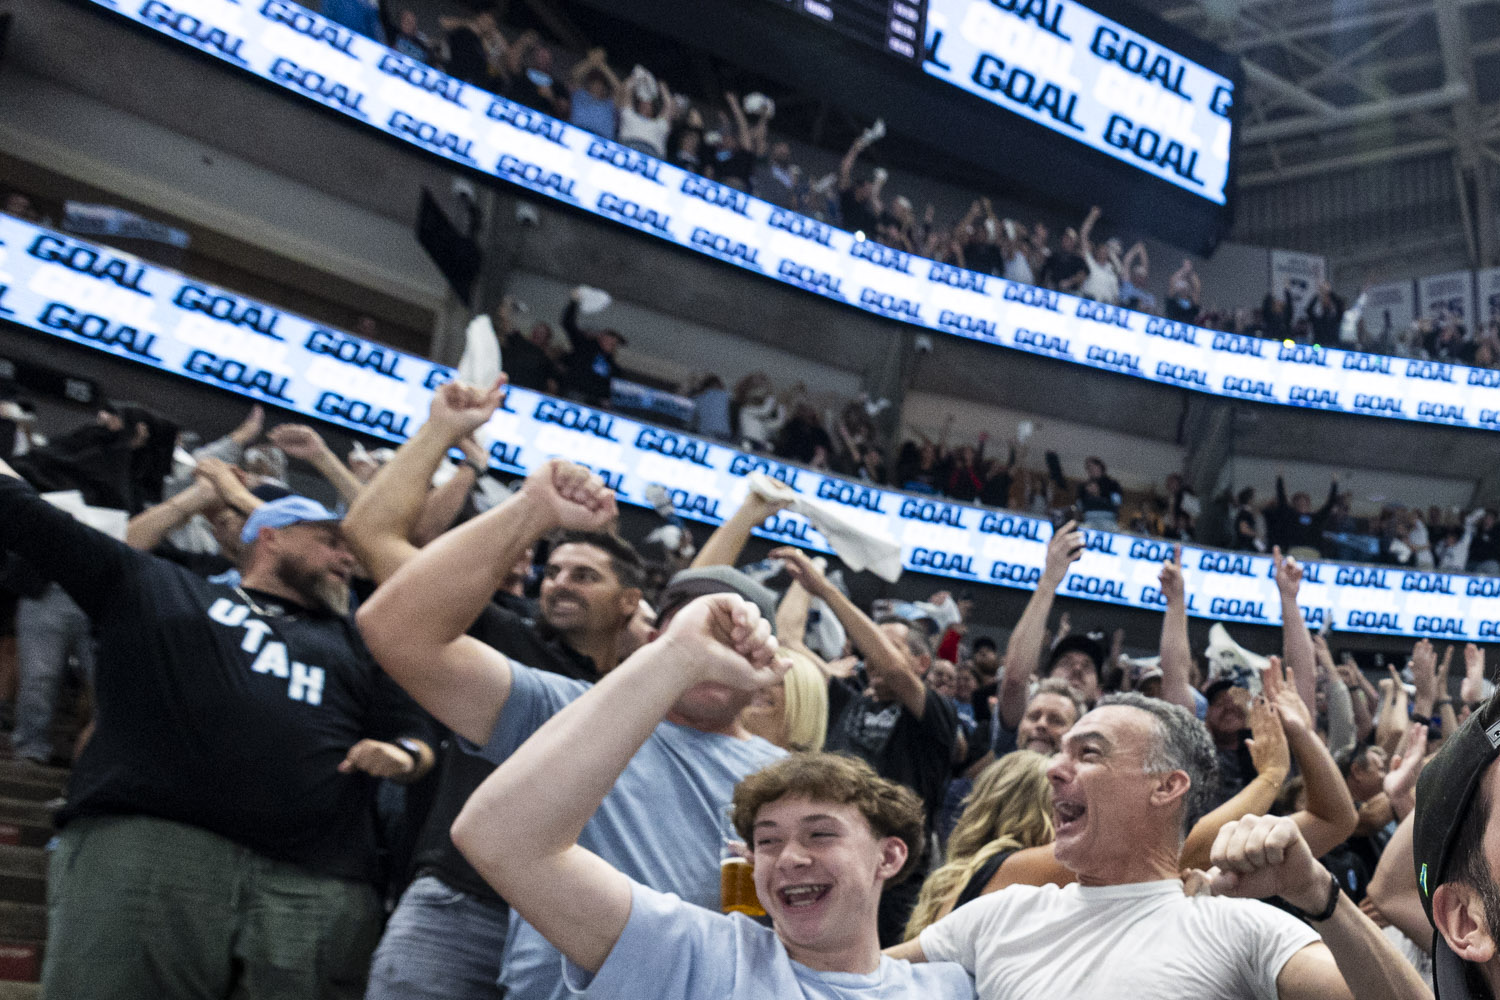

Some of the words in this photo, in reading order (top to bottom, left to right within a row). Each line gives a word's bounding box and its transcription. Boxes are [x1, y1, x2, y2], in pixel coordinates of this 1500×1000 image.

[376, 55, 468, 107] GOAL
[485, 100, 569, 146] GOAL
[586, 141, 665, 184] GOAL
[681, 178, 751, 217] GOAL
[767, 211, 834, 247] GOAL
[849, 241, 913, 274] GOAL
[927, 265, 989, 294] GOAL
[971, 53, 1085, 131] GOAL
[1103, 113, 1205, 186] GOAL
[1090, 25, 1193, 101] GOAL
[137, 0, 252, 63] GOAL
[268, 58, 368, 113] GOAL
[386, 111, 477, 160] GOAL
[494, 155, 579, 199] GOAL
[595, 193, 673, 233] GOAL
[689, 228, 761, 264] GOAL
[776, 260, 843, 292] GOAL
[859, 289, 923, 318] GOAL
[937, 311, 999, 337] GOAL
[1013, 329, 1072, 354] GOAL
[1085, 346, 1142, 370] GOAL
[1155, 362, 1208, 385] GOAL
[1222, 377, 1274, 396] GOAL
[1288, 387, 1341, 406] GOAL
[1353, 395, 1404, 413] GOAL
[1416, 403, 1466, 420] GOAL
[25, 233, 158, 297] GOAL
[171, 284, 289, 341] GOAL
[303, 329, 409, 381] GOAL
[532, 400, 621, 442] GOAL
[633, 429, 717, 468] GOAL
[815, 480, 888, 514] GOAL
[898, 499, 969, 529] GOAL
[979, 512, 1045, 543] GOAL
[1129, 541, 1187, 568] GOA
[1198, 553, 1259, 577] GOAL
[1334, 568, 1393, 589] GOAL
[1400, 575, 1457, 595] GOAL
[36, 302, 168, 362] GOAL
[182, 349, 300, 403] GOAL
[313, 392, 414, 438] GOAL
[666, 486, 724, 520] OAL
[909, 548, 979, 575] GOAL
[990, 561, 1042, 584] GOA
[1067, 574, 1128, 600] GOAL
[1209, 598, 1270, 619] GOAL
[1346, 611, 1405, 630] GOAL
[1413, 616, 1466, 634] GOAL
[207, 596, 326, 706] UTAH
